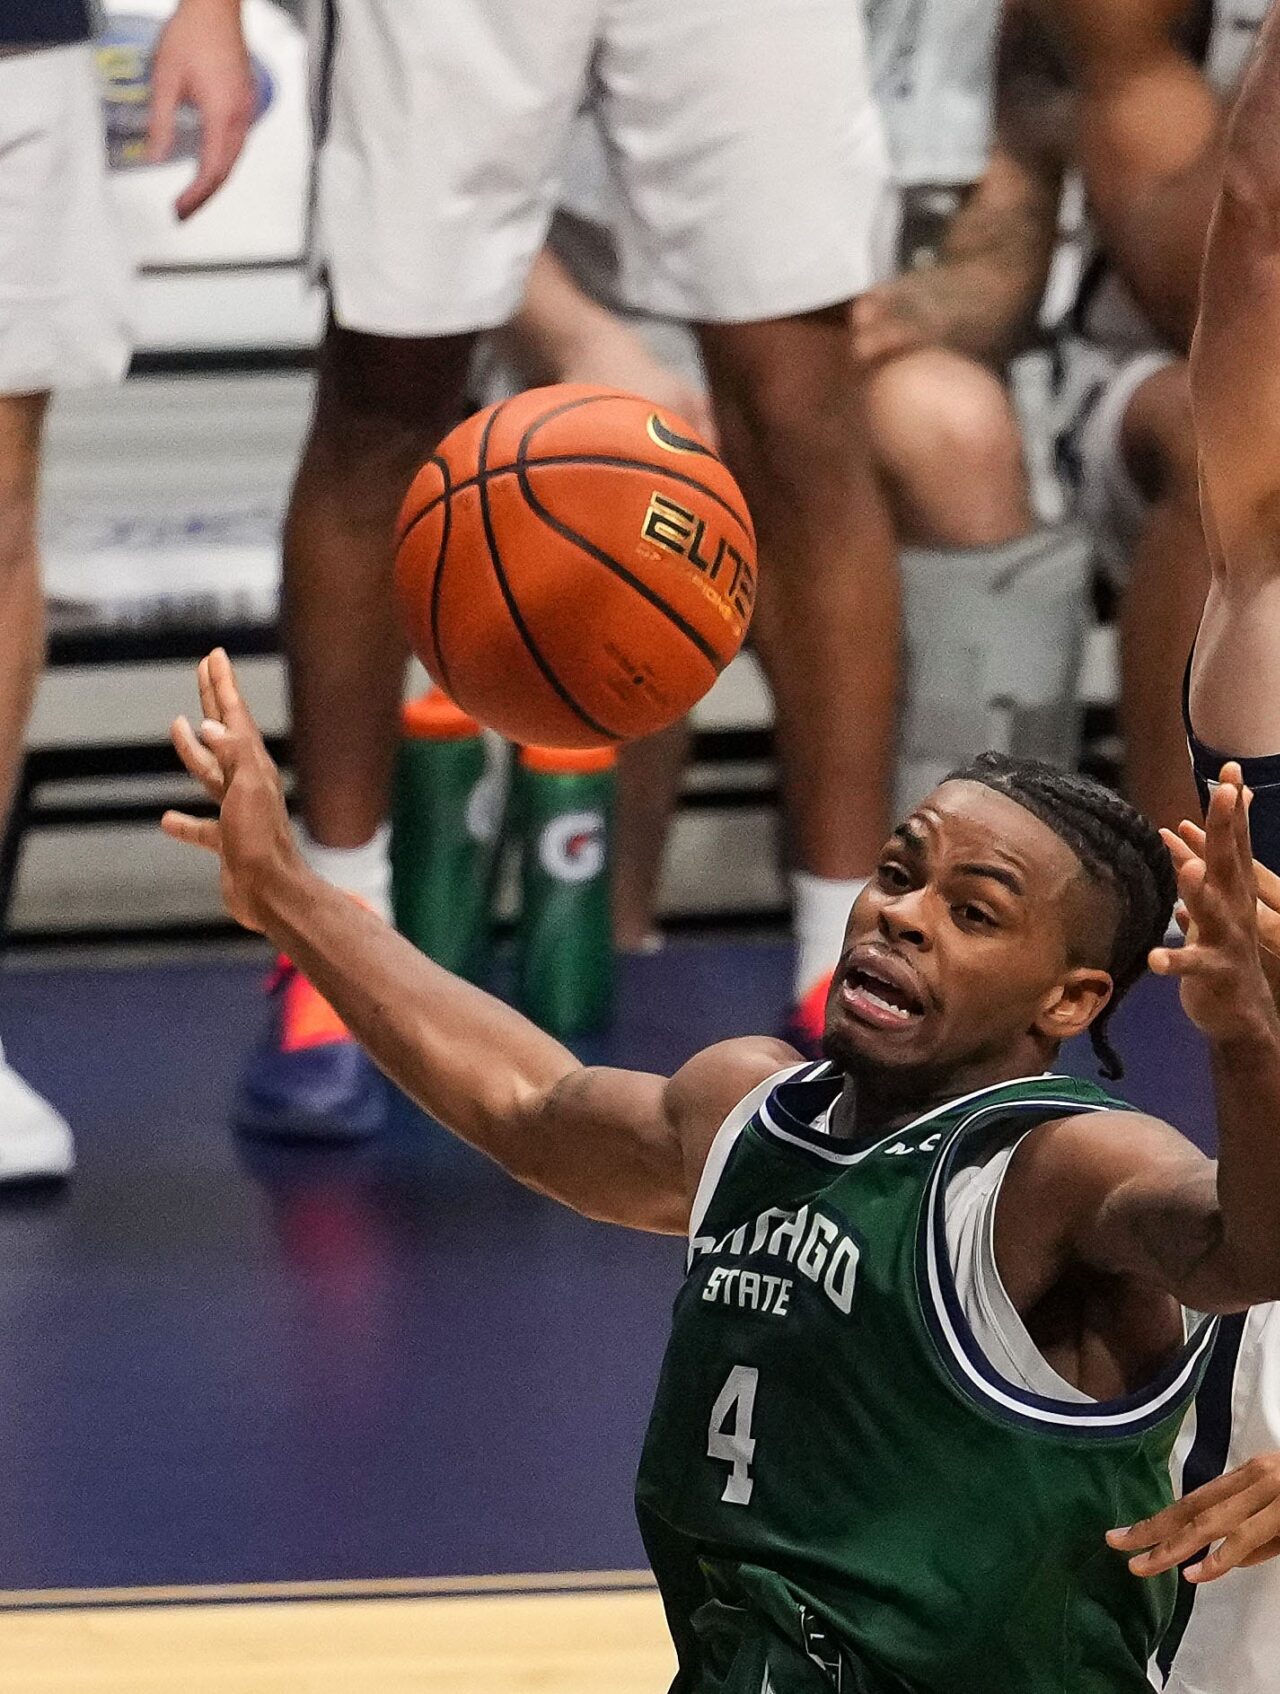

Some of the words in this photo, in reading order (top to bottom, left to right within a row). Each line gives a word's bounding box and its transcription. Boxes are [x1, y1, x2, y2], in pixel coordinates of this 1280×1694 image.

[641, 490, 754, 620] ELITE
[540, 812, 606, 883] G
[702, 1266, 793, 1316] STATE
[707, 1365, 759, 1505] 4
